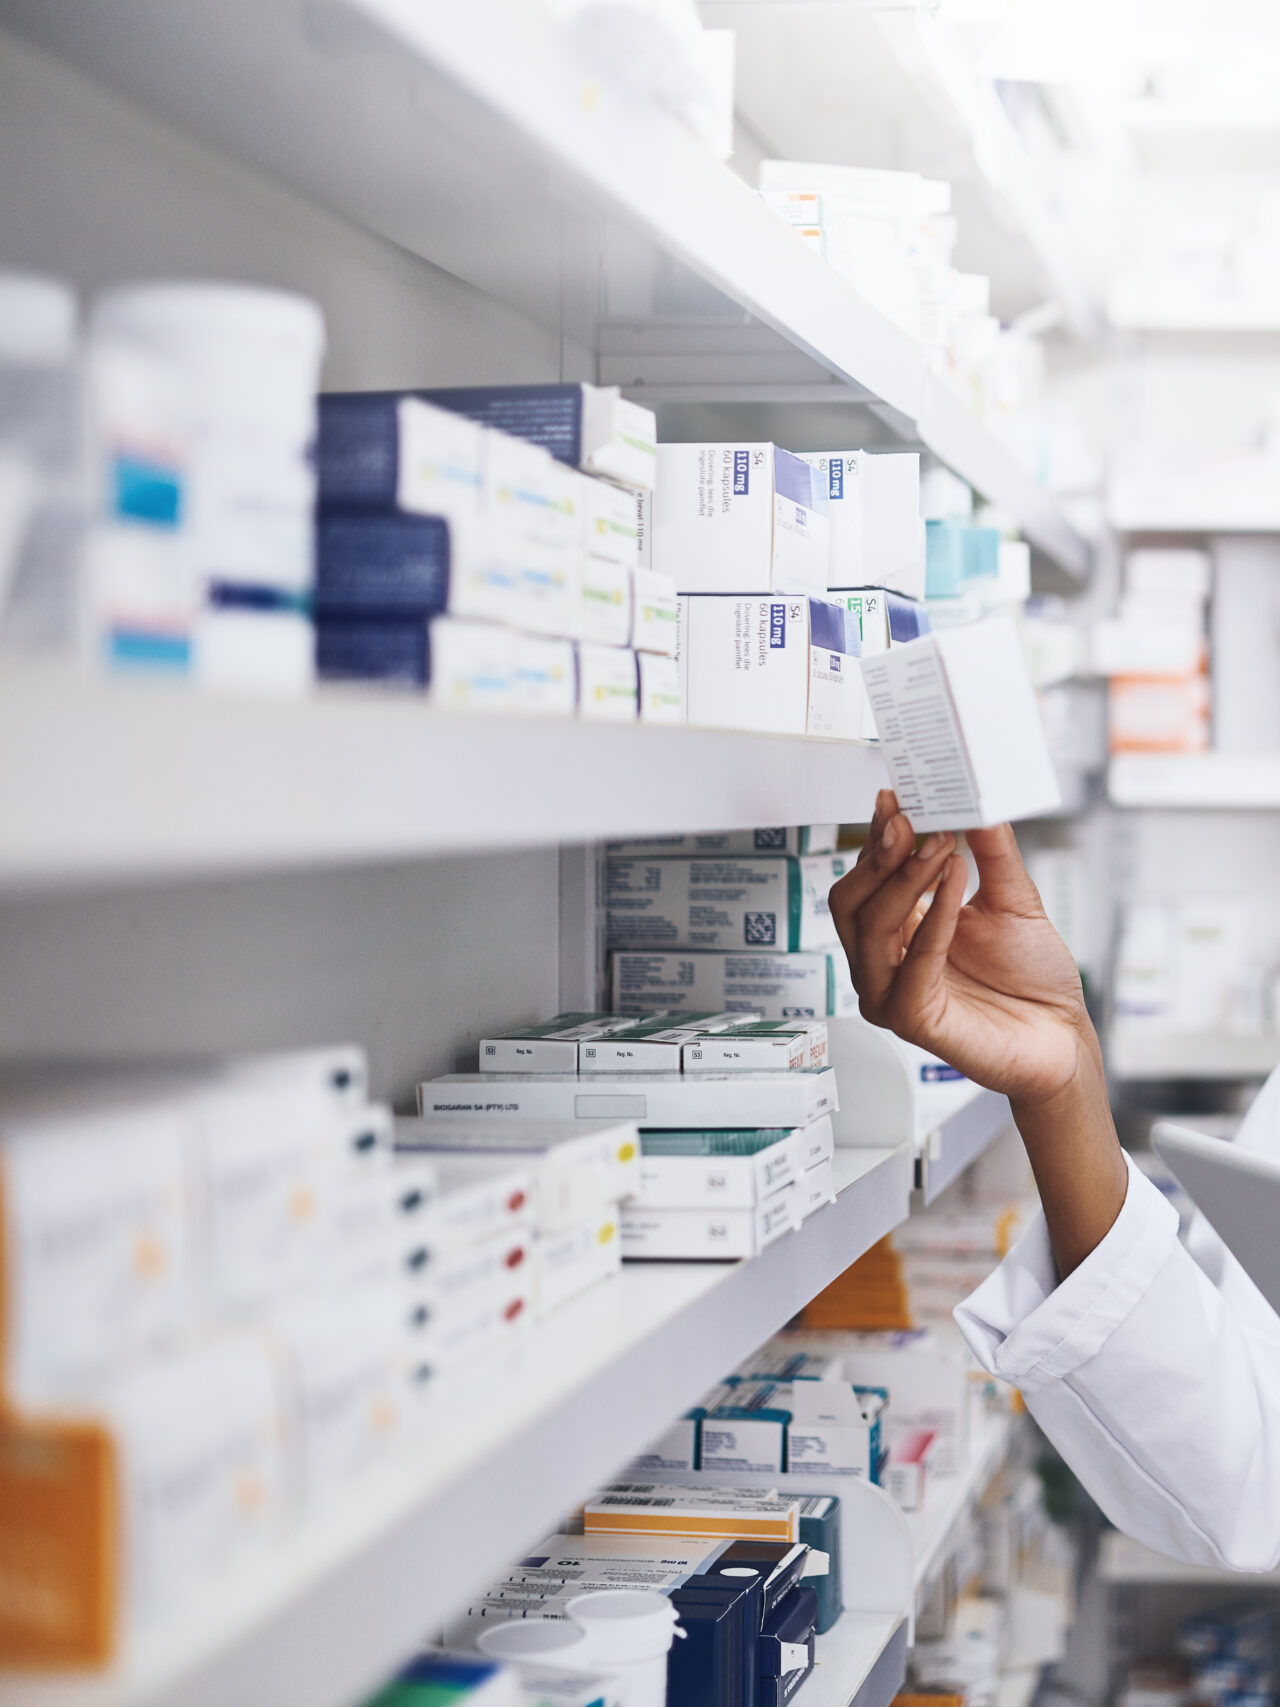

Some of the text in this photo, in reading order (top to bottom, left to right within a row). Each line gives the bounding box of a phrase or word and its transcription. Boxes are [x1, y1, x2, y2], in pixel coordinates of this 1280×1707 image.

[734, 452, 747, 492] 110 mg
[753, 451, 765, 465] S4
[819, 458, 828, 471] 60
[846, 459, 856, 472] S4
[721, 449, 732, 513] 60 kapsules
[830, 460, 841, 497] 110 mg
[790, 605, 801, 619] S4
[866, 598, 877, 612] S4
[757, 603, 769, 666] 60 kapsules
[771, 605, 784, 645] 110 mg
[734, 639, 743, 669] pamflet
